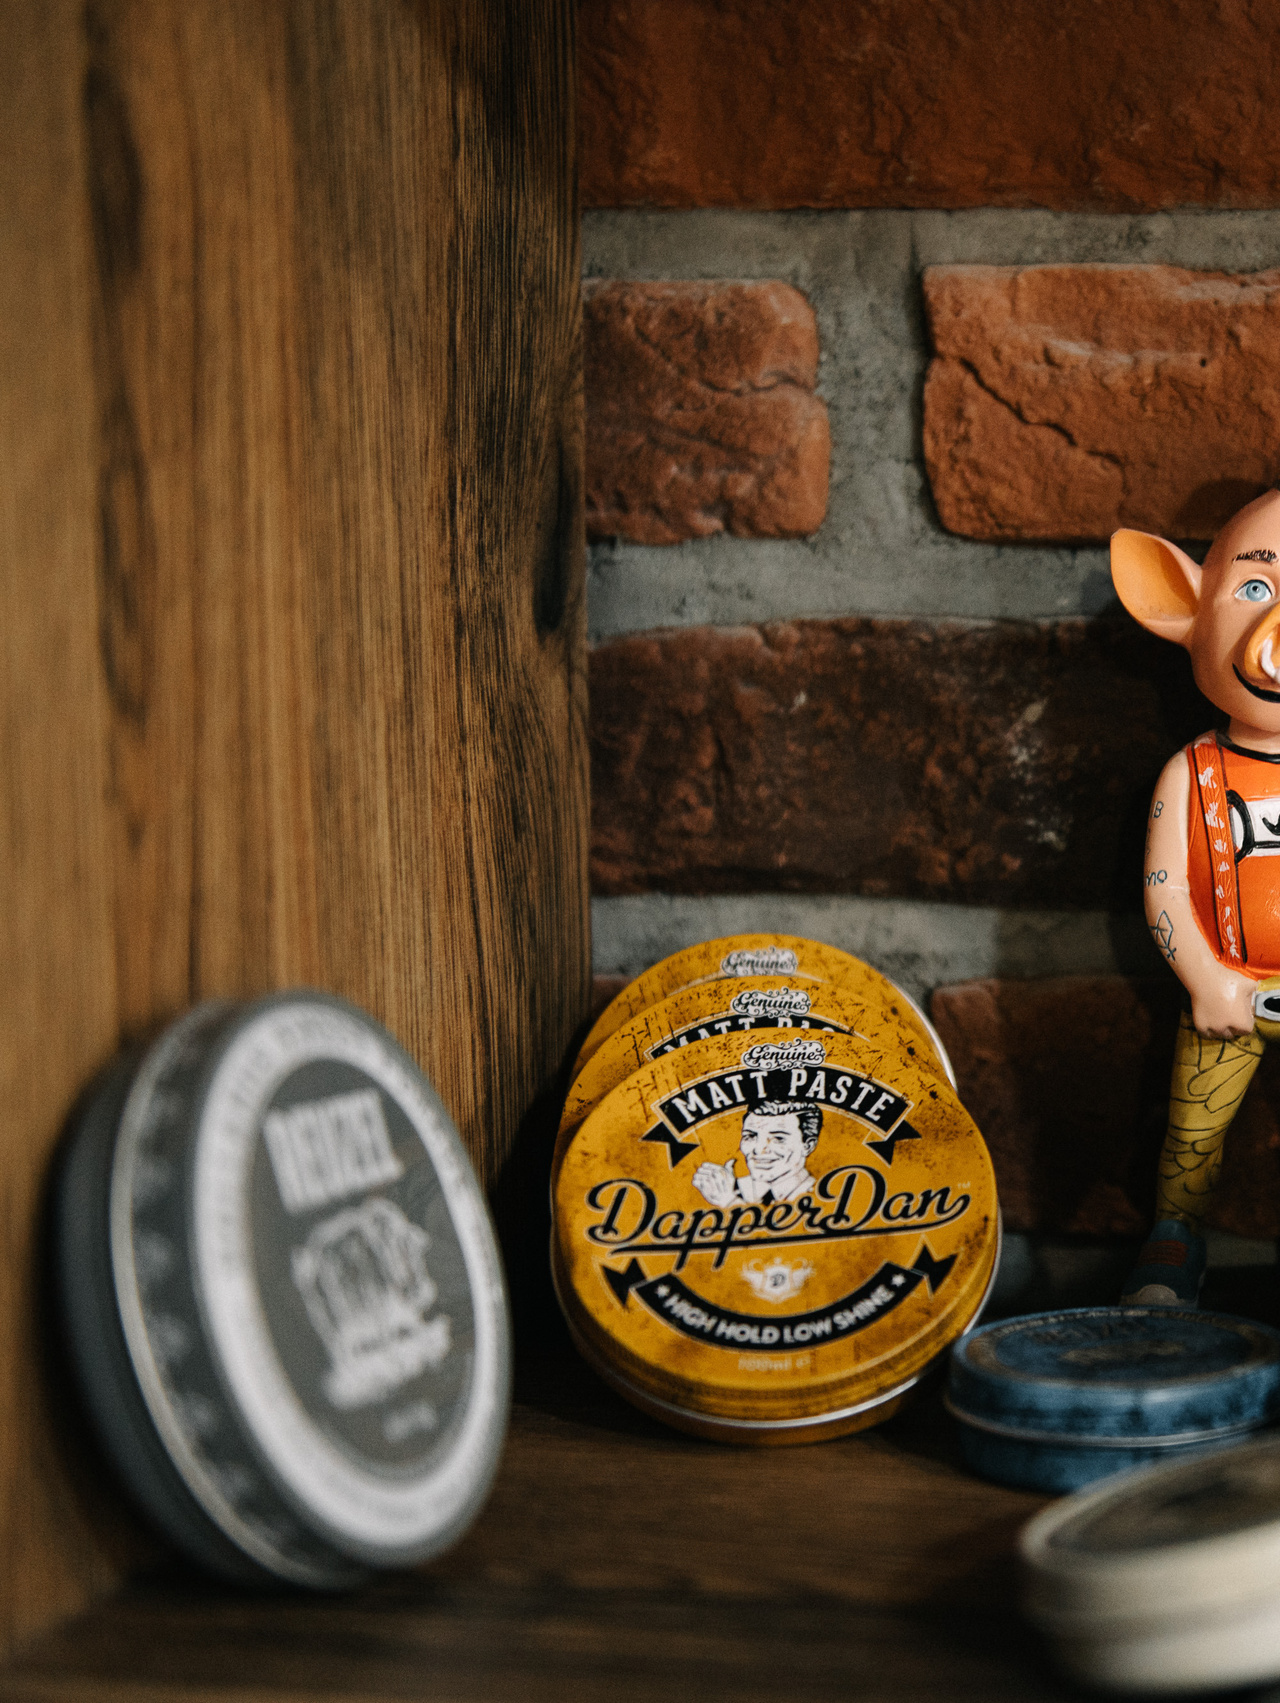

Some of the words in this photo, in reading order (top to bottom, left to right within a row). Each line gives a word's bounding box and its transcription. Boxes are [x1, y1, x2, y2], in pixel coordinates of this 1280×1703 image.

[738, 993, 802, 1013] Genuine
[750, 1044, 816, 1064] Genuine
[671, 1070, 769, 1125] MATT
[787, 1069, 896, 1123] PASTE
[586, 1178, 823, 1272] Dapper
[815, 1164, 972, 1235] Dan
[663, 1292, 719, 1333] HIGH
[714, 1319, 781, 1345] HOLD
[783, 1316, 833, 1344] LOW
[832, 1283, 897, 1331] SHINE
